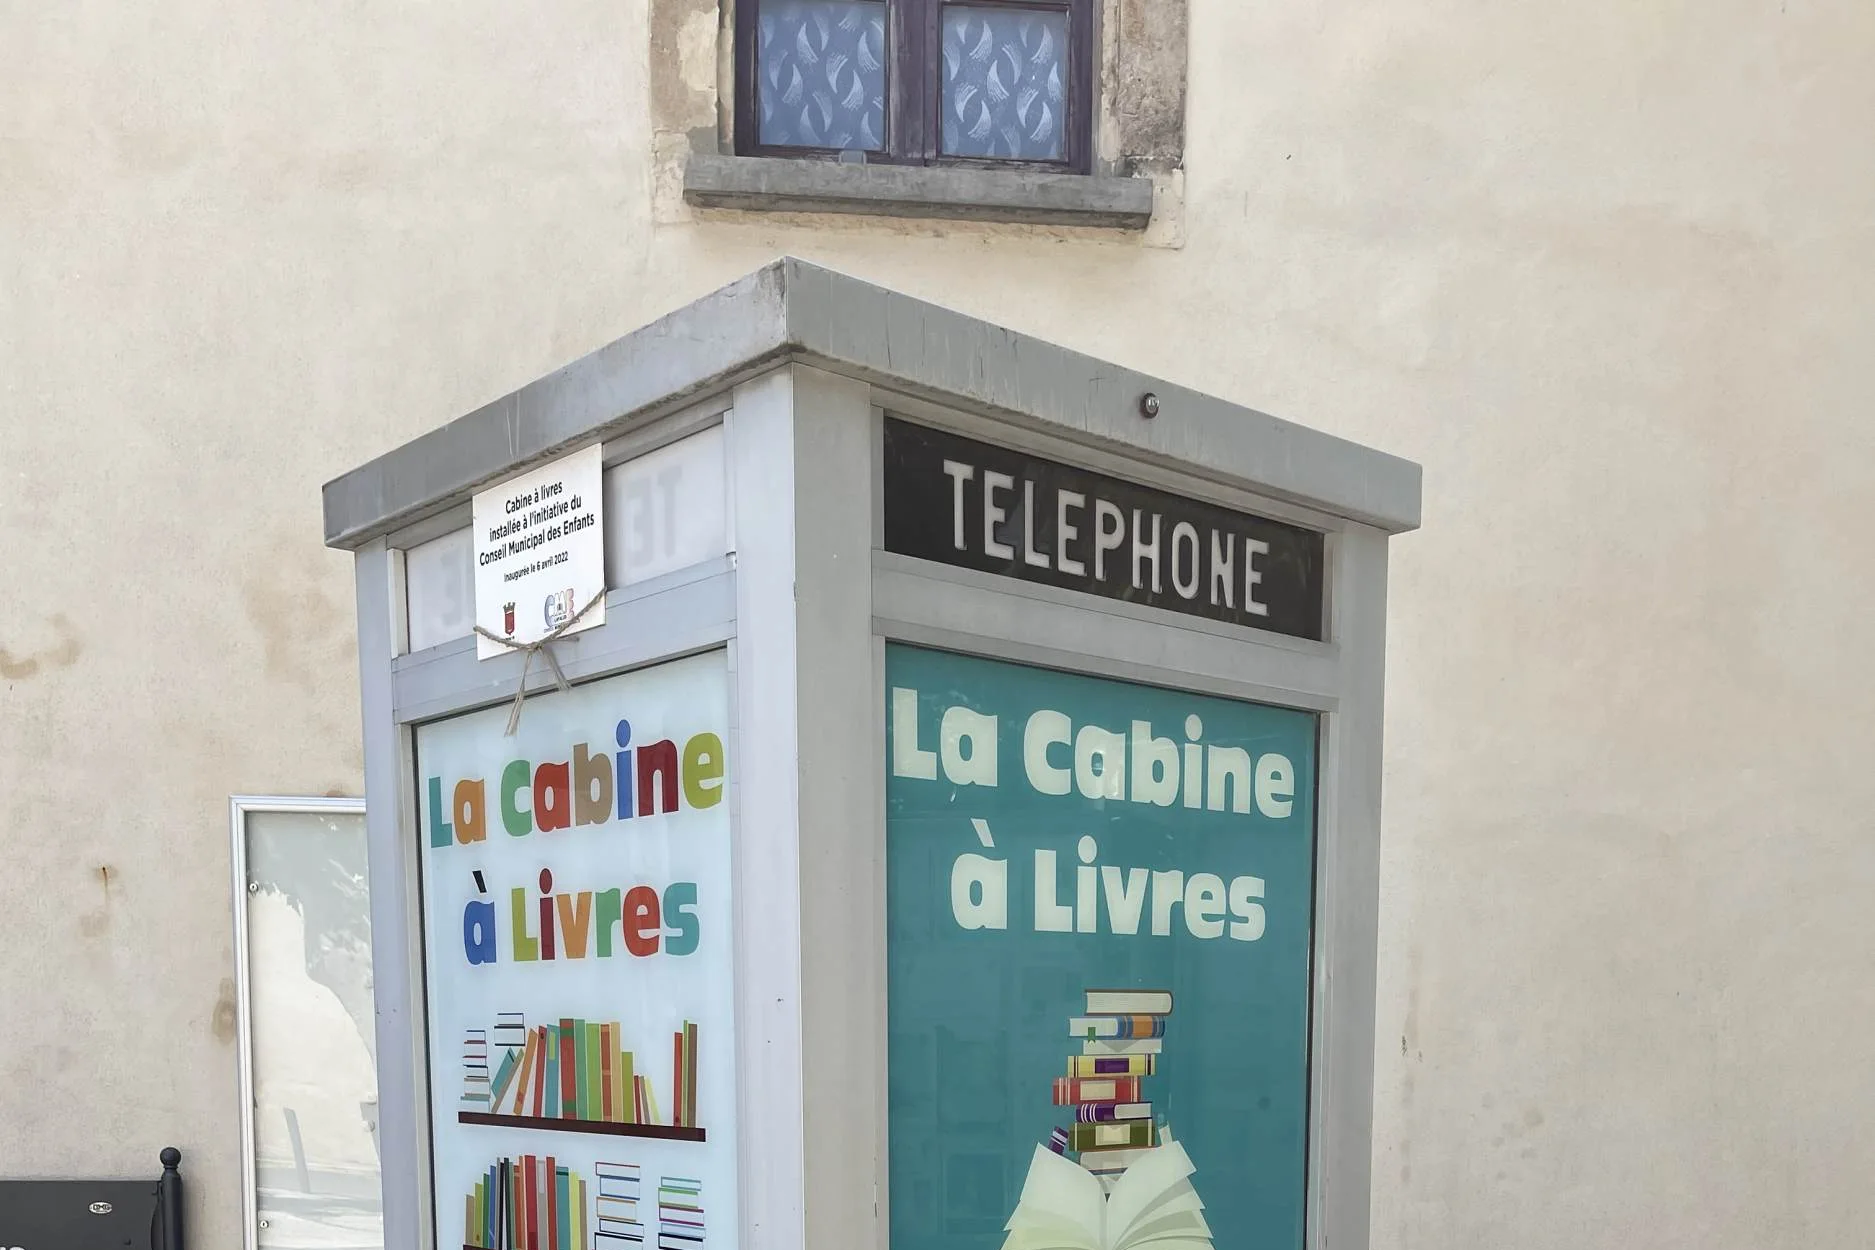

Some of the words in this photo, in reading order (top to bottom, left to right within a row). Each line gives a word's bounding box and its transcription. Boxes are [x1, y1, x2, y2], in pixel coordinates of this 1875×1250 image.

[489, 518, 521, 543] installée
[523, 514, 528, 530] à
[529, 501, 569, 528] l'initiative
[570, 493, 582, 511] du
[505, 493, 533, 515] Cabine
[534, 487, 540, 503] à
[540, 481, 563, 500] livres
[479, 543, 507, 566] Conseil
[508, 528, 546, 556] Municipal
[547, 525, 562, 542] des
[563, 512, 595, 536] Enfants
[530, 562, 536, 573] le
[536, 560, 541, 571] 6
[541, 555, 554, 570] avril
[554, 550, 569, 565] 2022
[943, 459, 1269, 616] TELEPHONE
[893, 687, 998, 787] La
[428, 776, 486, 848] La
[951, 818, 1008, 930] à
[1034, 835, 1266, 942] Livres
[463, 870, 497, 965] à
[511, 868, 700, 962] Livres
